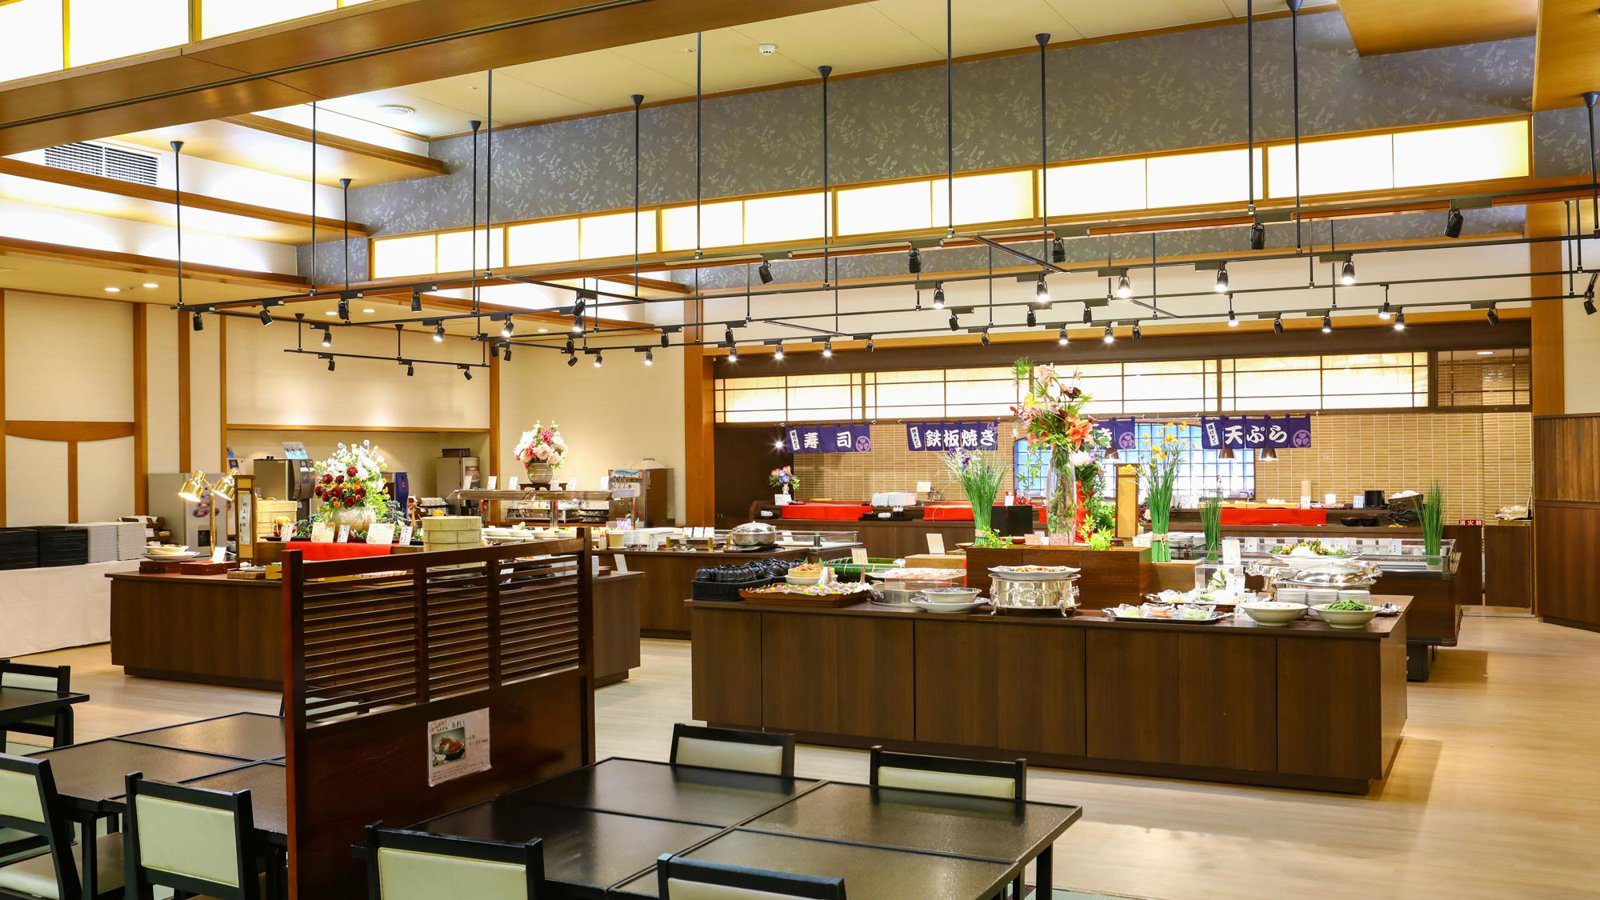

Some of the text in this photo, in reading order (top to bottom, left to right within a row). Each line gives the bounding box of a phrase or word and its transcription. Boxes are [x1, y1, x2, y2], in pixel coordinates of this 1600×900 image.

[804, 431, 852, 448] 寿司
[925, 429, 996, 448] 鉄板焼き
[1225, 425, 1288, 445] 天ぷら
